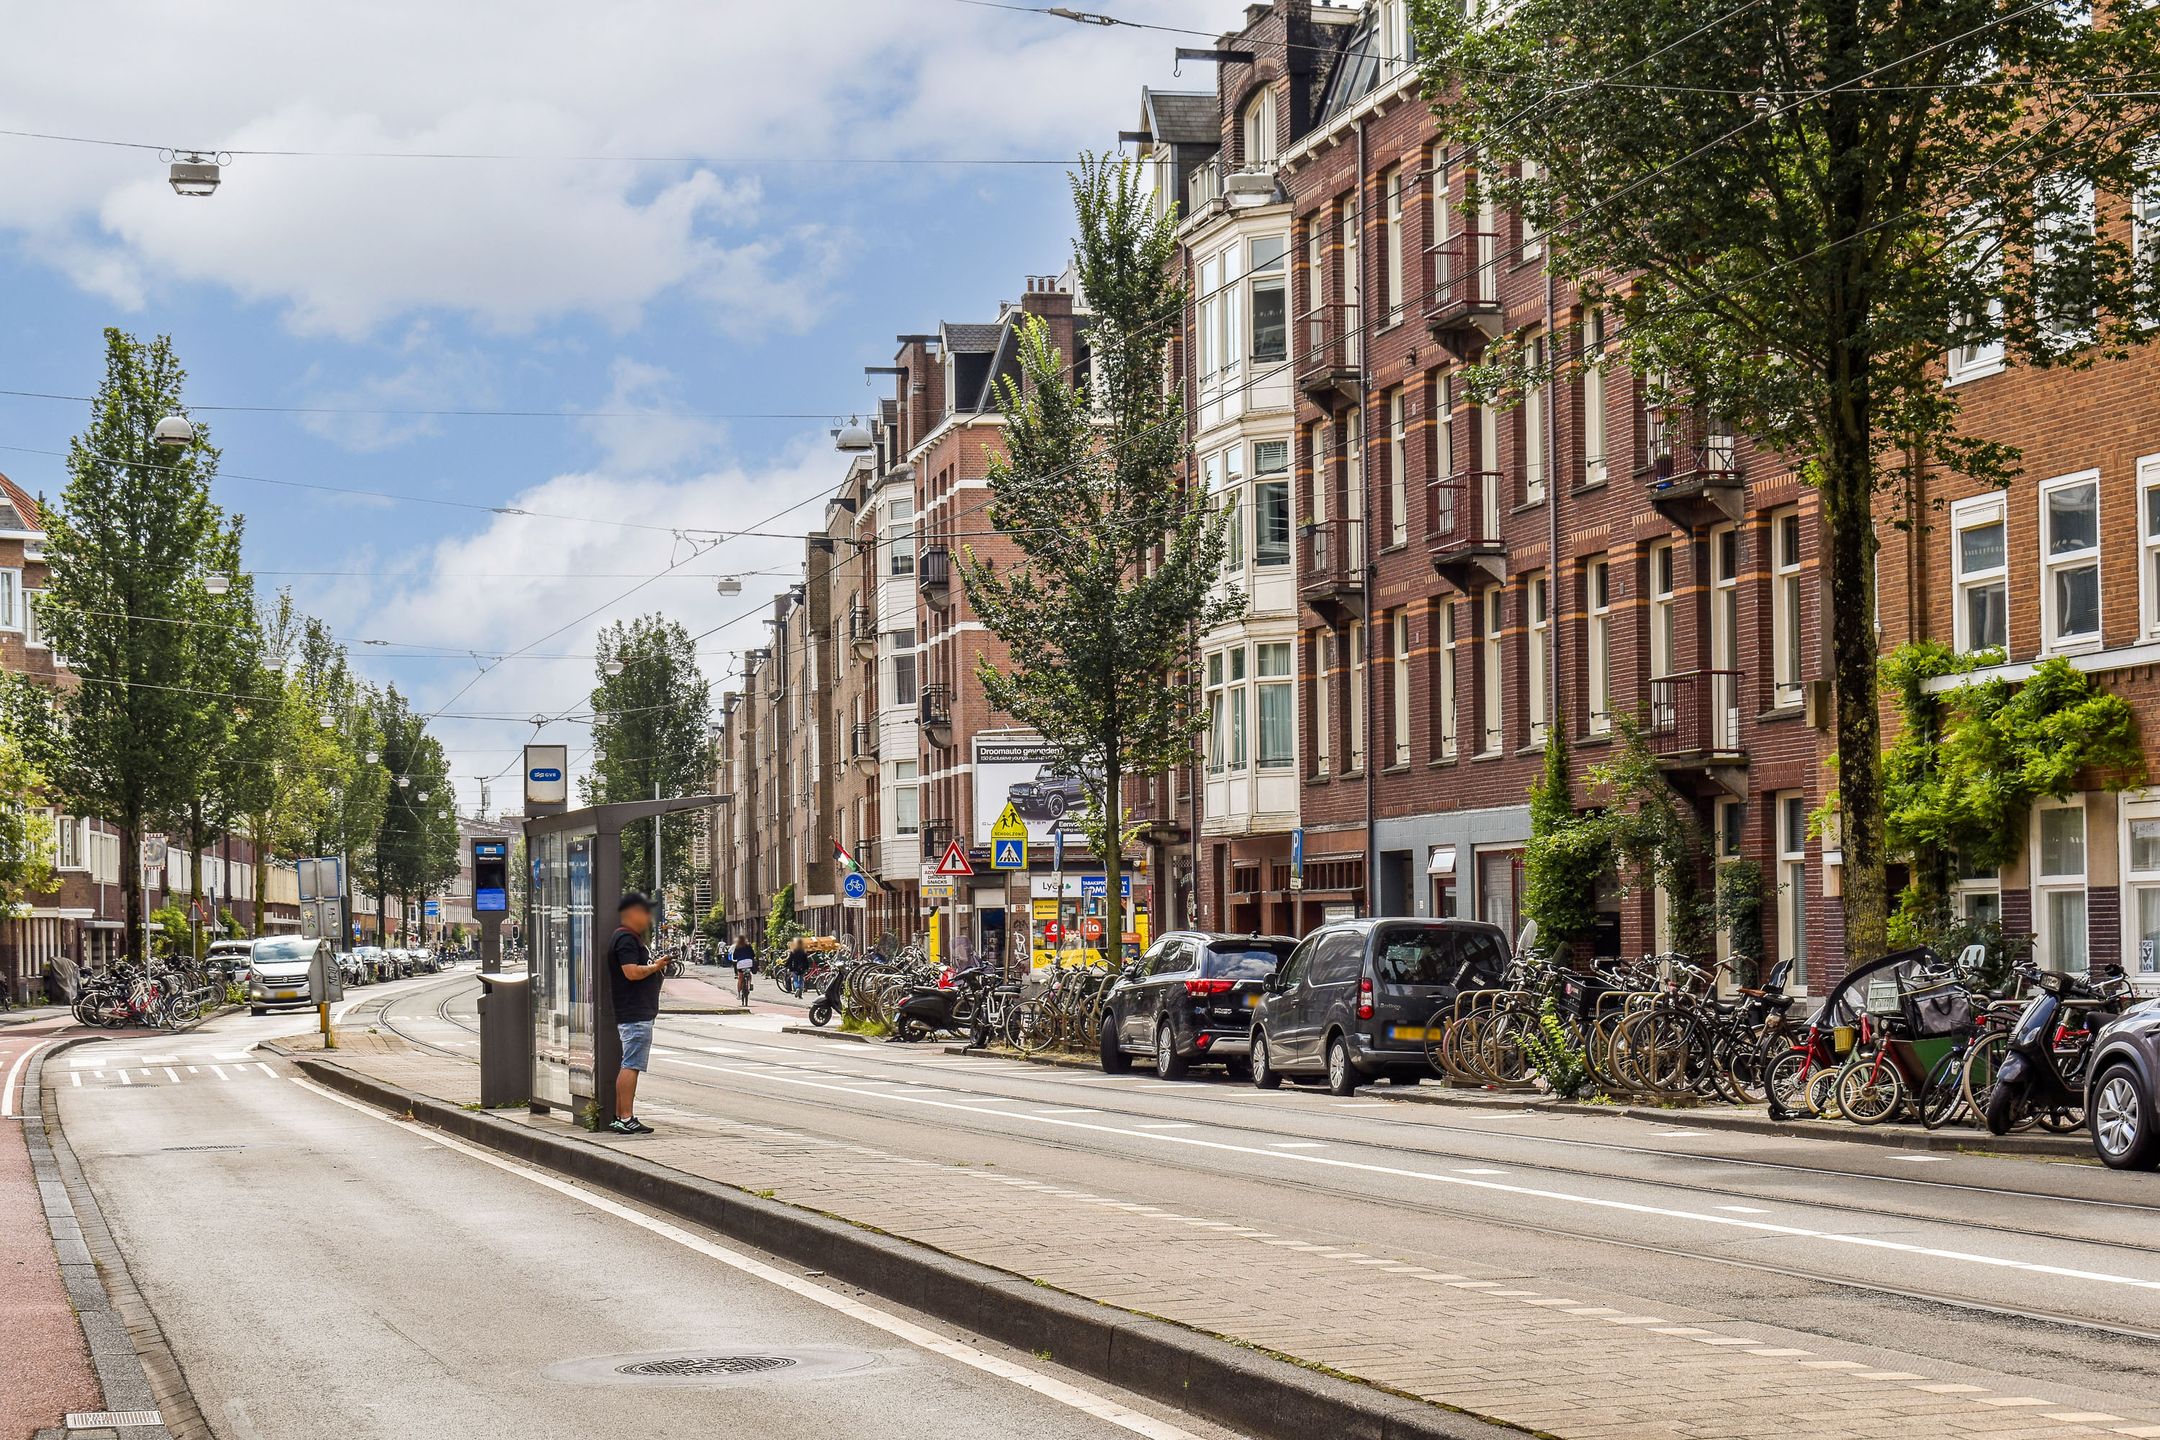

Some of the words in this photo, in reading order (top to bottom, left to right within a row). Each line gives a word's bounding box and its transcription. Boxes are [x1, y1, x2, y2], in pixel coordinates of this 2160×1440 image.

[980, 747, 1022, 755] Droomauto
[1042, 881, 1064, 891] Lyc
[927, 887, 947, 895] ATM
